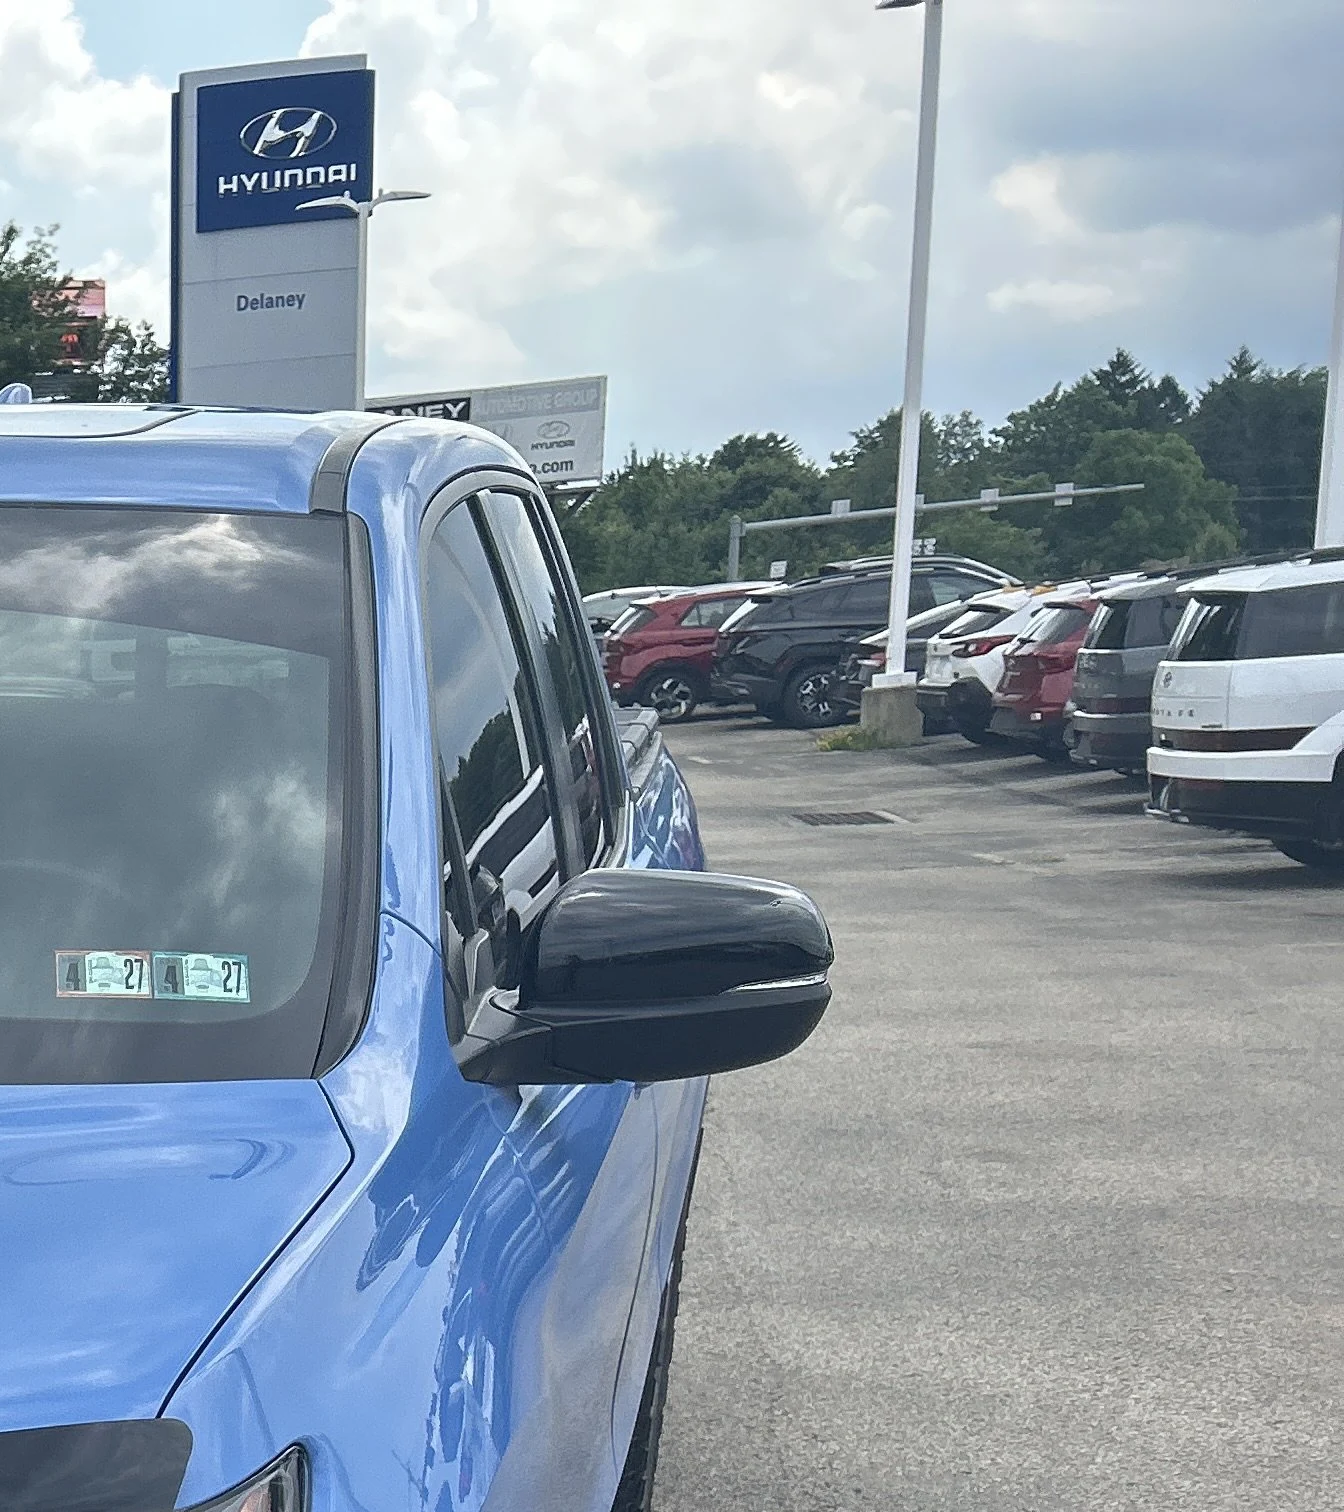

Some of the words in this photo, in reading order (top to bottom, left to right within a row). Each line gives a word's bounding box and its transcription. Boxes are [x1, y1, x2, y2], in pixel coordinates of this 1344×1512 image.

[218, 163, 357, 195] HYUNDAI
[236, 292, 306, 312] Delaney
[530, 439, 576, 451] HYUNDAI
[65, 962, 81, 991] 4
[123, 958, 144, 990] 27
[221, 960, 242, 994] 27
